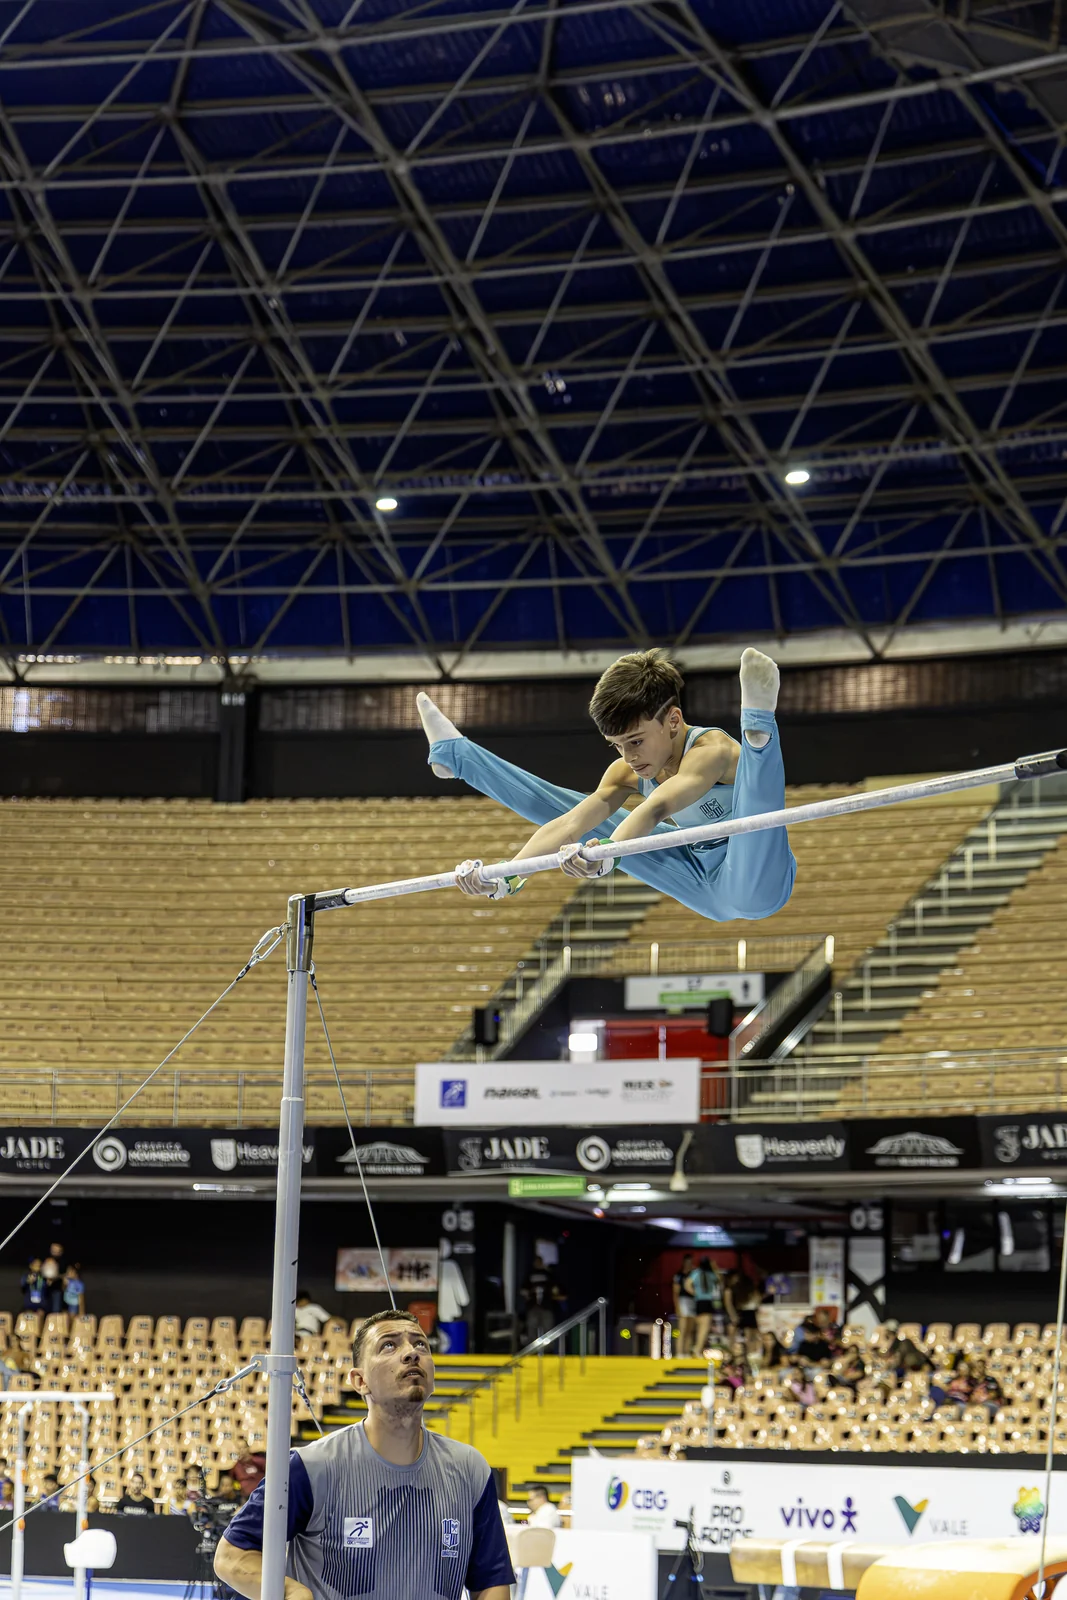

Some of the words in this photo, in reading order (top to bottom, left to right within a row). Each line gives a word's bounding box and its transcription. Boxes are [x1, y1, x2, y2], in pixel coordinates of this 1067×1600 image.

[0, 1136, 65, 1159] JADE
[237, 1142, 314, 1163] Heavy
[484, 1136, 550, 1160] JADE
[764, 1134, 845, 1158] Heavenly
[442, 1210, 475, 1232] 05
[850, 1207, 884, 1231] 05
[632, 1489, 668, 1510] CBG
[711, 1505, 744, 1524] PRO
[780, 1497, 835, 1529] vivo
[930, 1518, 969, 1536] VALE
[573, 1583, 609, 1600] VALE
